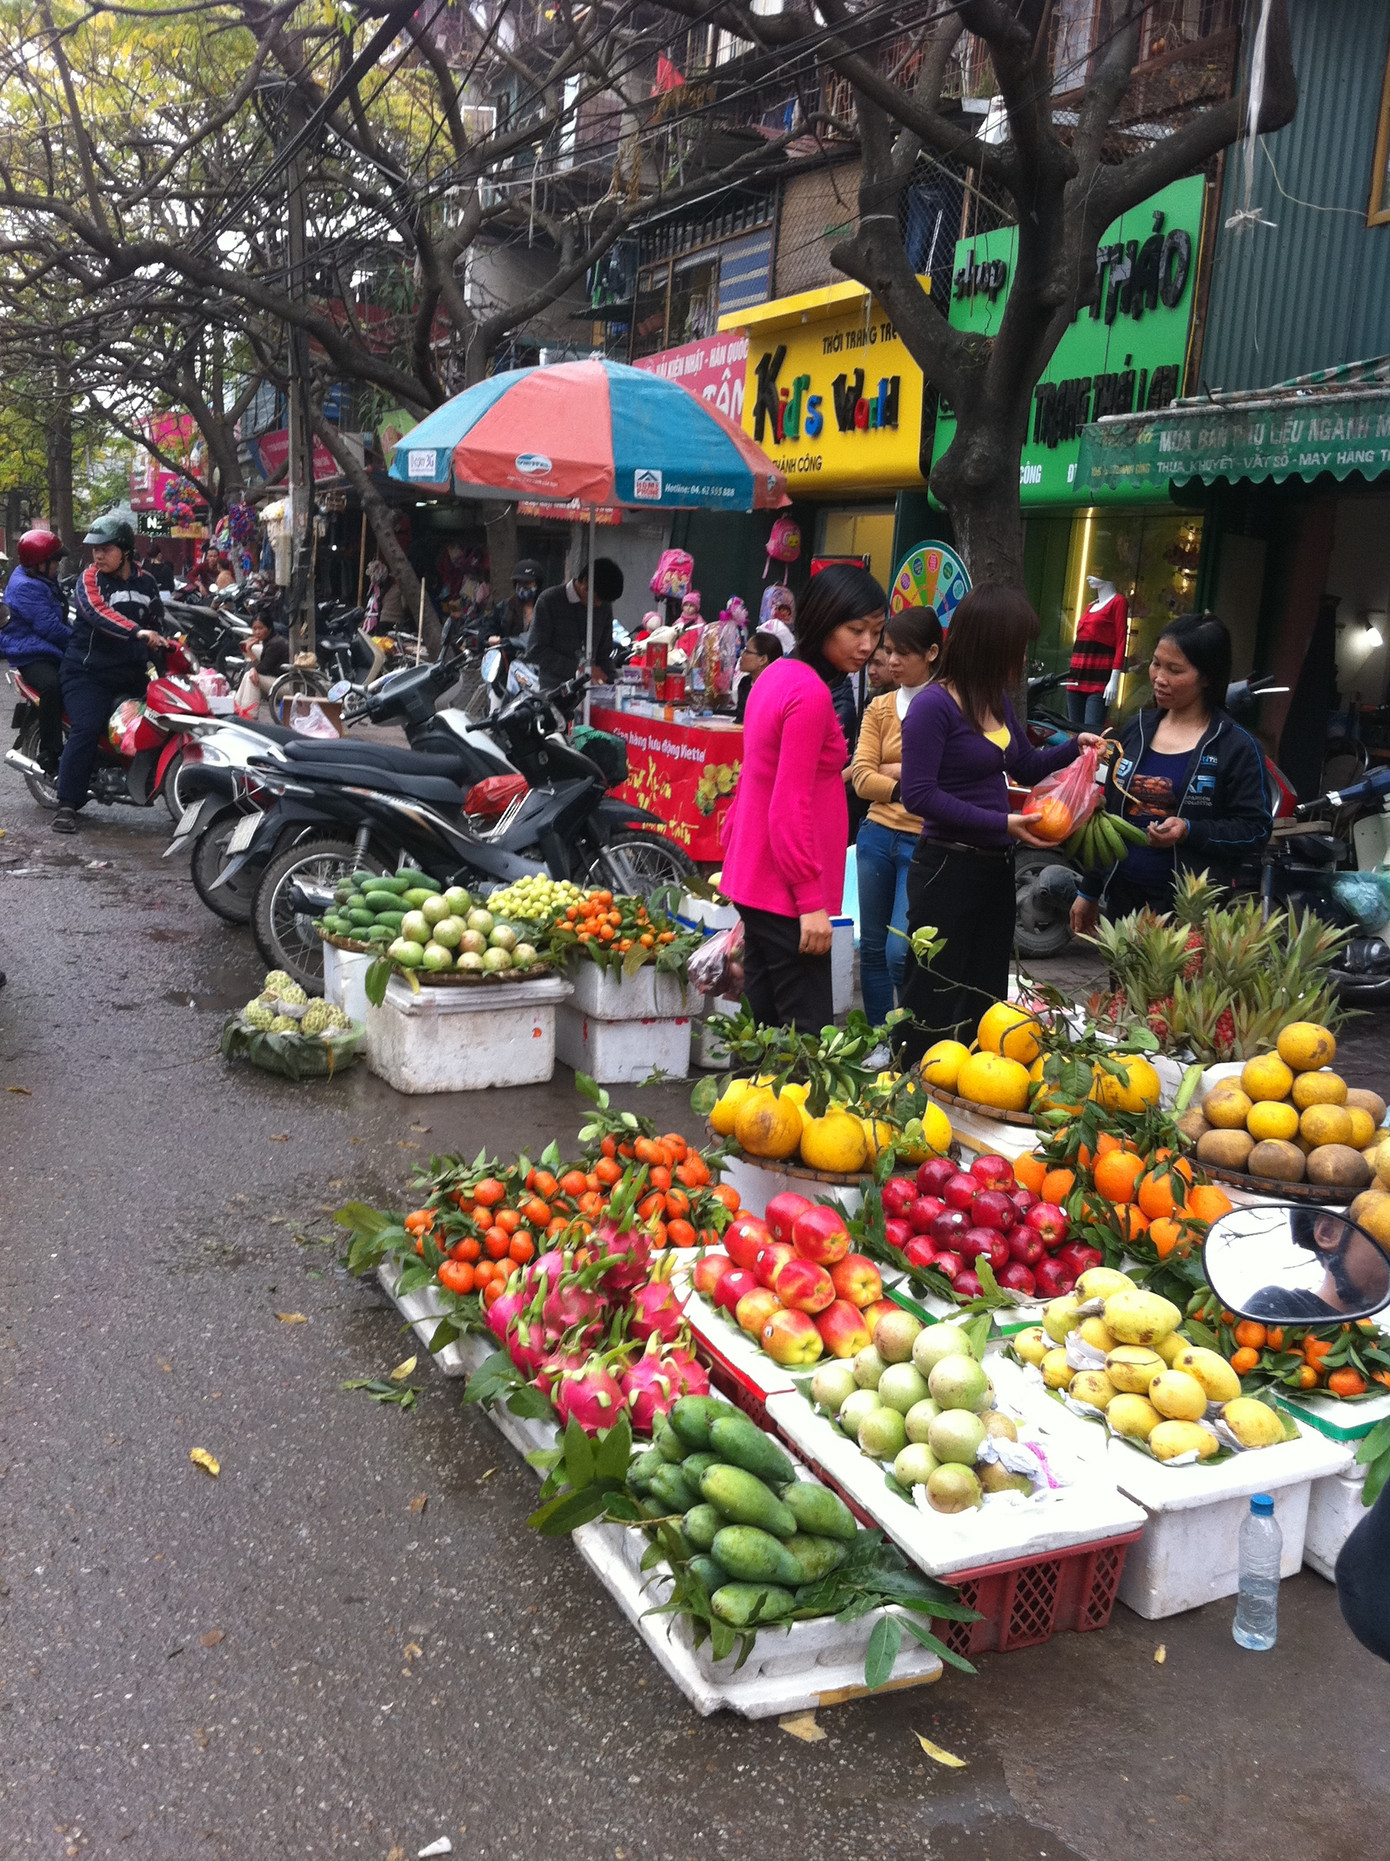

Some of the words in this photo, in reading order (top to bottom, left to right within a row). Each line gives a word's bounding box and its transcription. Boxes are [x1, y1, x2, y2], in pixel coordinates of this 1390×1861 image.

[846, 326, 877, 350] TRANG
[1299, 452, 1331, 465] MAY
[680, 744, 706, 763] Viettel
